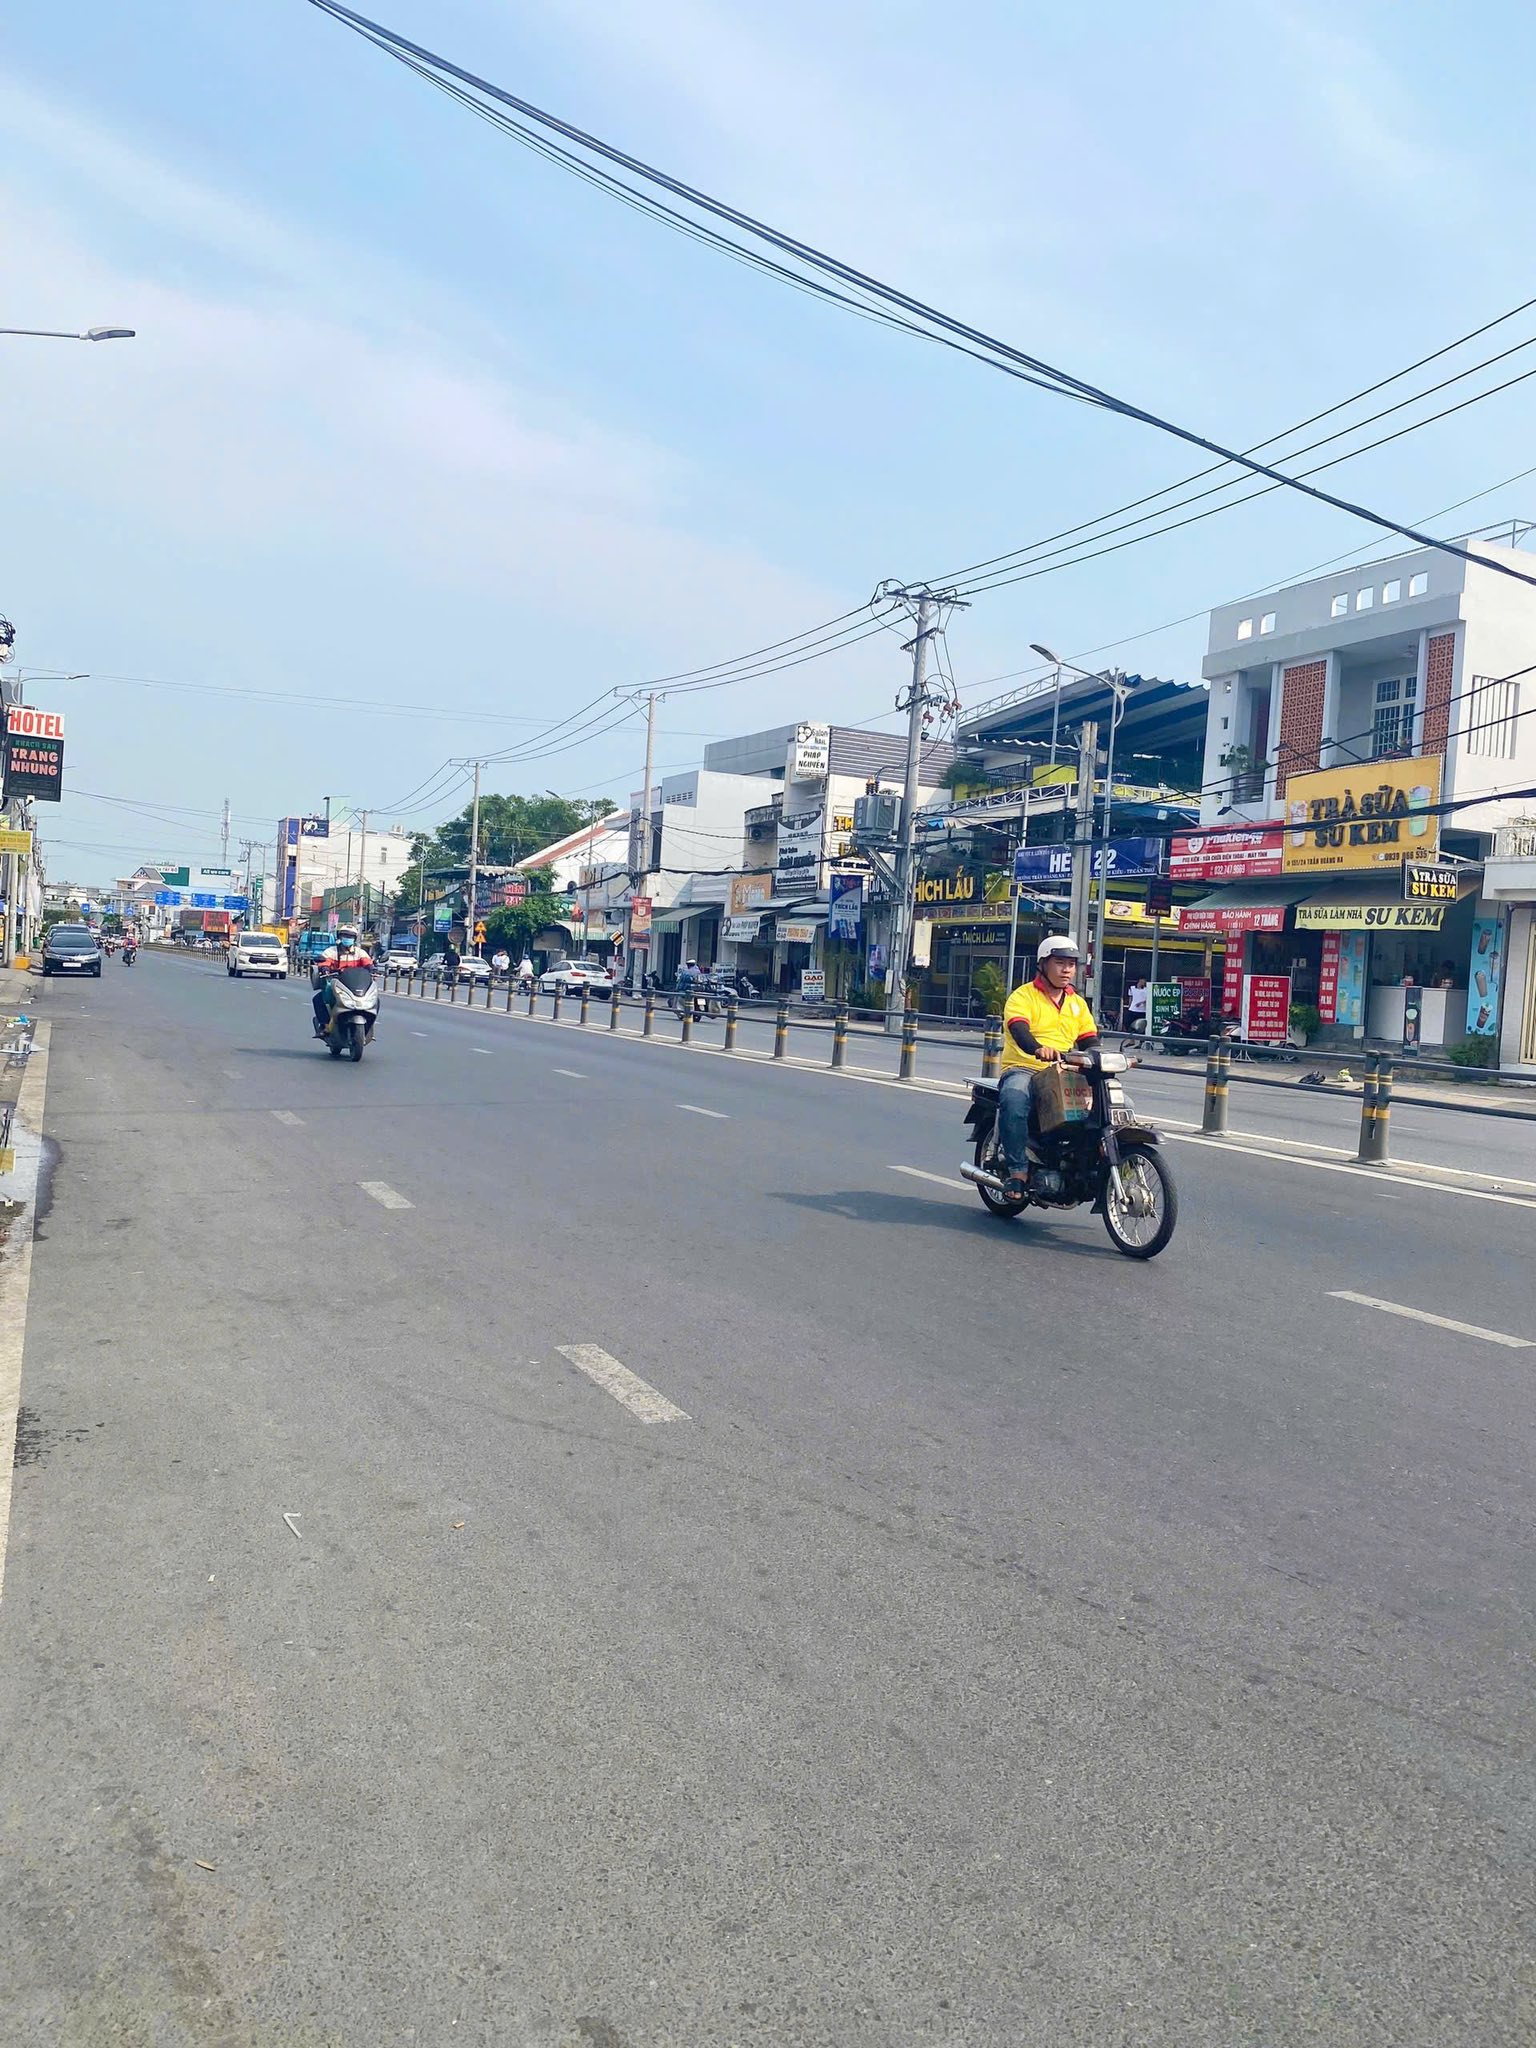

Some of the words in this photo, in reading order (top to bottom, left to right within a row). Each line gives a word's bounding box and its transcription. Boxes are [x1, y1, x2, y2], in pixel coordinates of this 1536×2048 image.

[9, 709, 63, 738] HOTEL
[11, 747, 58, 763] TRANG
[11, 761, 58, 776] NHUNG
[1310, 789, 1357, 820] TRÀ
[1360, 784, 1409, 816] SỮA
[1315, 825, 1345, 848] SU
[1349, 820, 1400, 846] KEM
[1050, 846, 1072, 873] HẺ
[1093, 849, 1117, 870] 22
[945, 865, 974, 900] LẨU
[1419, 869, 1436, 882] TRÀ
[1438, 870, 1457, 884] SỮA
[1411, 882, 1429, 896] SU
[1430, 883, 1456, 899] KEM
[1254, 914, 1260, 926] 12
[1261, 912, 1279, 927] THÁNG
[1299, 906, 1312, 919] TRÀ
[1314, 905, 1328, 919] SỮA
[1364, 907, 1392, 926] SU
[1394, 906, 1441, 926] KEM
[1153, 986, 1171, 997] NƯỚC
[1172, 986, 1181, 997] ÉP
[1155, 1005, 1170, 1013] SINH
